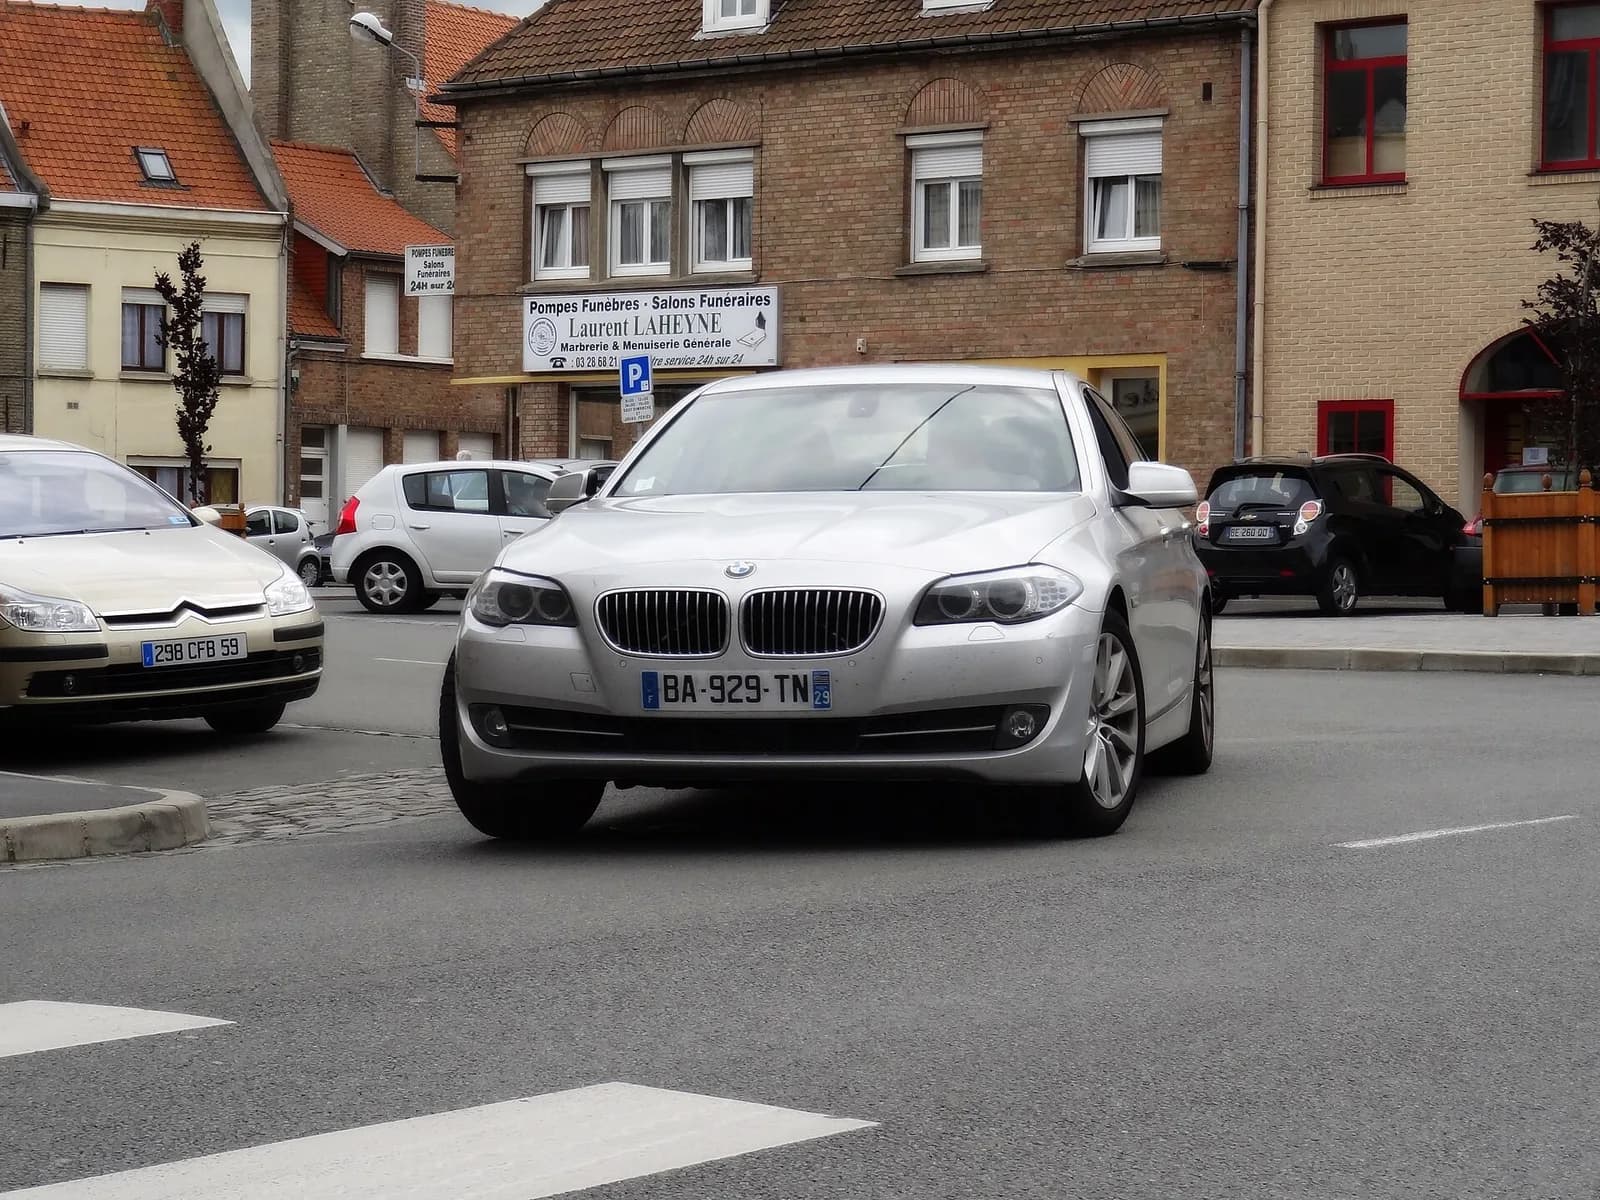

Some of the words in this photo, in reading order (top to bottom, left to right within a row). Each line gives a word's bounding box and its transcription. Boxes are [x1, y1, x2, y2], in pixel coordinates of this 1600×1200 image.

[411, 248, 432, 258] POMPES
[423, 260, 445, 269] Salons
[410, 280, 428, 292] 24H
[430, 282, 445, 290] sur
[529, 301, 578, 317] Pompes
[582, 297, 640, 313] Funèbres
[652, 295, 696, 310] Salons
[699, 292, 771, 308] Funéraires
[569, 317, 630, 338] Laurent
[634, 312, 722, 336] LAHEYNE
[560, 341, 609, 353] Marbrerie
[612, 340, 620, 351] &
[623, 338, 680, 350] Menuiserie
[683, 337, 732, 349] Générale
[575, 357, 585, 368] 03
[586, 356, 596, 368] 28
[597, 356, 607, 368] 68
[608, 356, 618, 368] 21
[664, 354, 696, 366] service
[696, 354, 714, 365] 24h
[715, 355, 730, 365] sur
[731, 353, 744, 364] 24
[628, 363, 643, 389] P
[154, 643, 184, 663] 298
[187, 640, 216, 660] CFB
[221, 638, 239, 656] 59
[663, 674, 809, 704] BA-929-TN
[813, 690, 830, 705] 29
